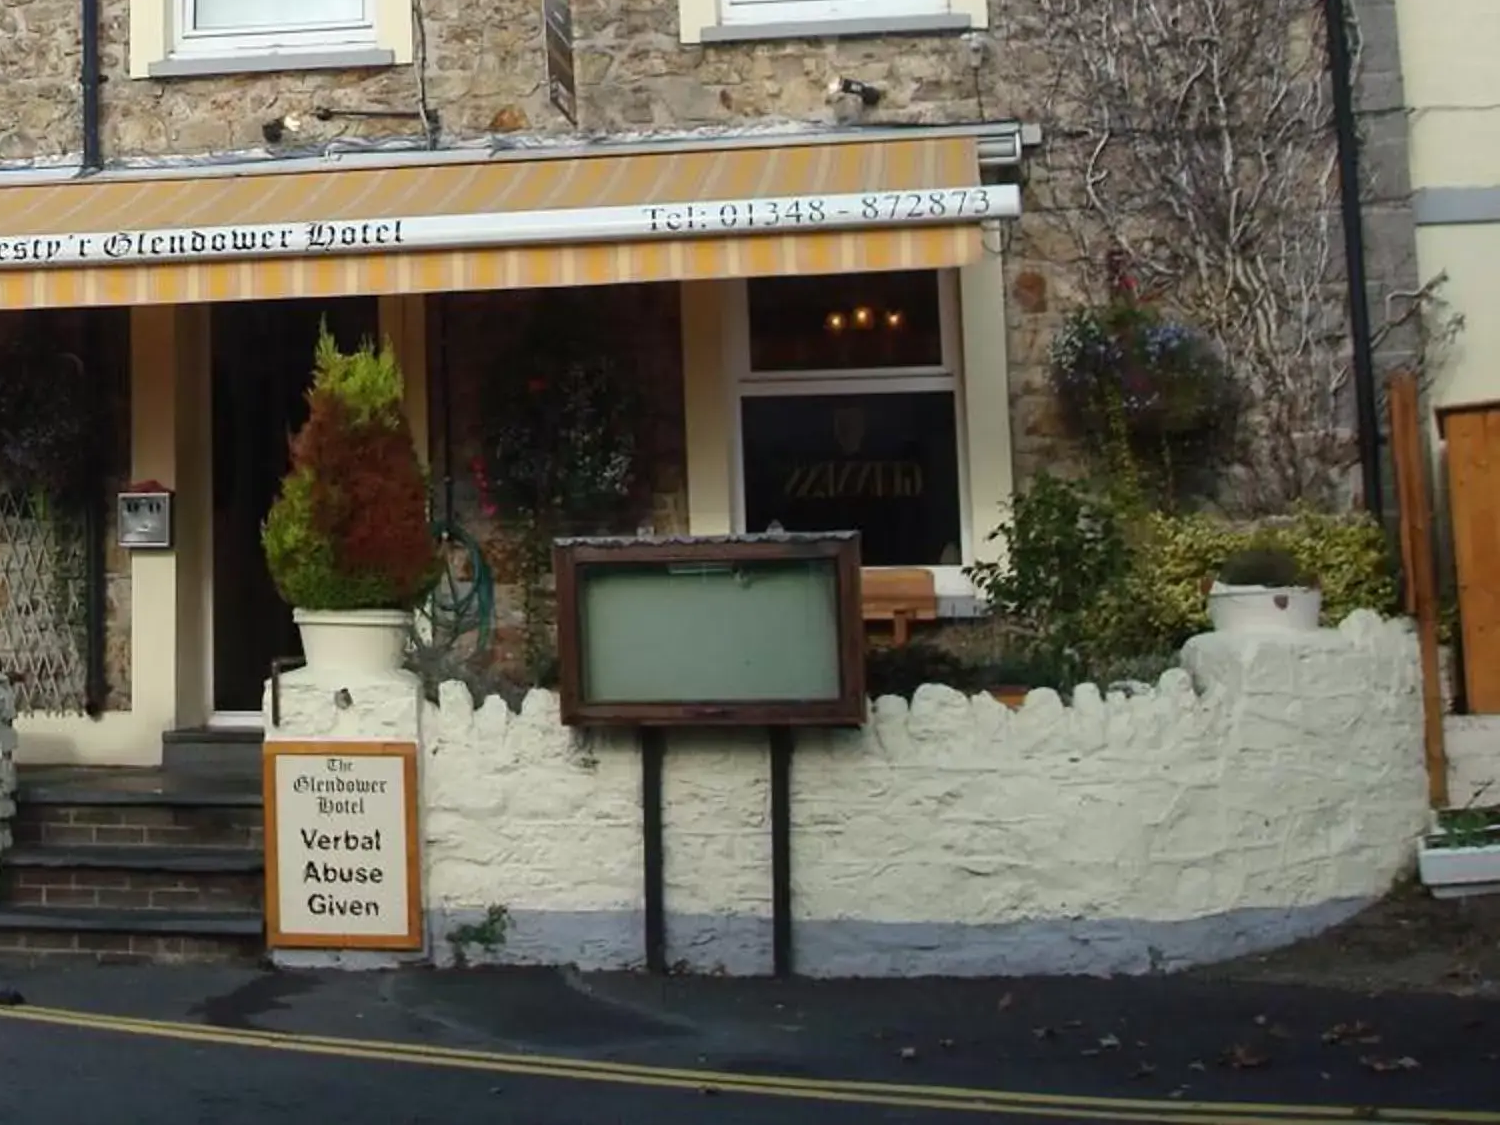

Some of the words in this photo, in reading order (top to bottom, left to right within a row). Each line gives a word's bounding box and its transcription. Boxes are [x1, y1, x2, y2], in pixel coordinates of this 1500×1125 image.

[642, 206, 707, 231] Tel:
[719, 199, 826, 227] 01348
[861, 189, 990, 221] 872873
[103, 227, 293, 257] Glendower
[304, 220, 404, 251] Hotel
[327, 758, 353, 772] The
[293, 775, 387, 793] Glendower
[316, 796, 364, 816] Hotel
[300, 828, 381, 851] Verbal
[303, 860, 383, 884] Abuse
[307, 893, 380, 917] Given
